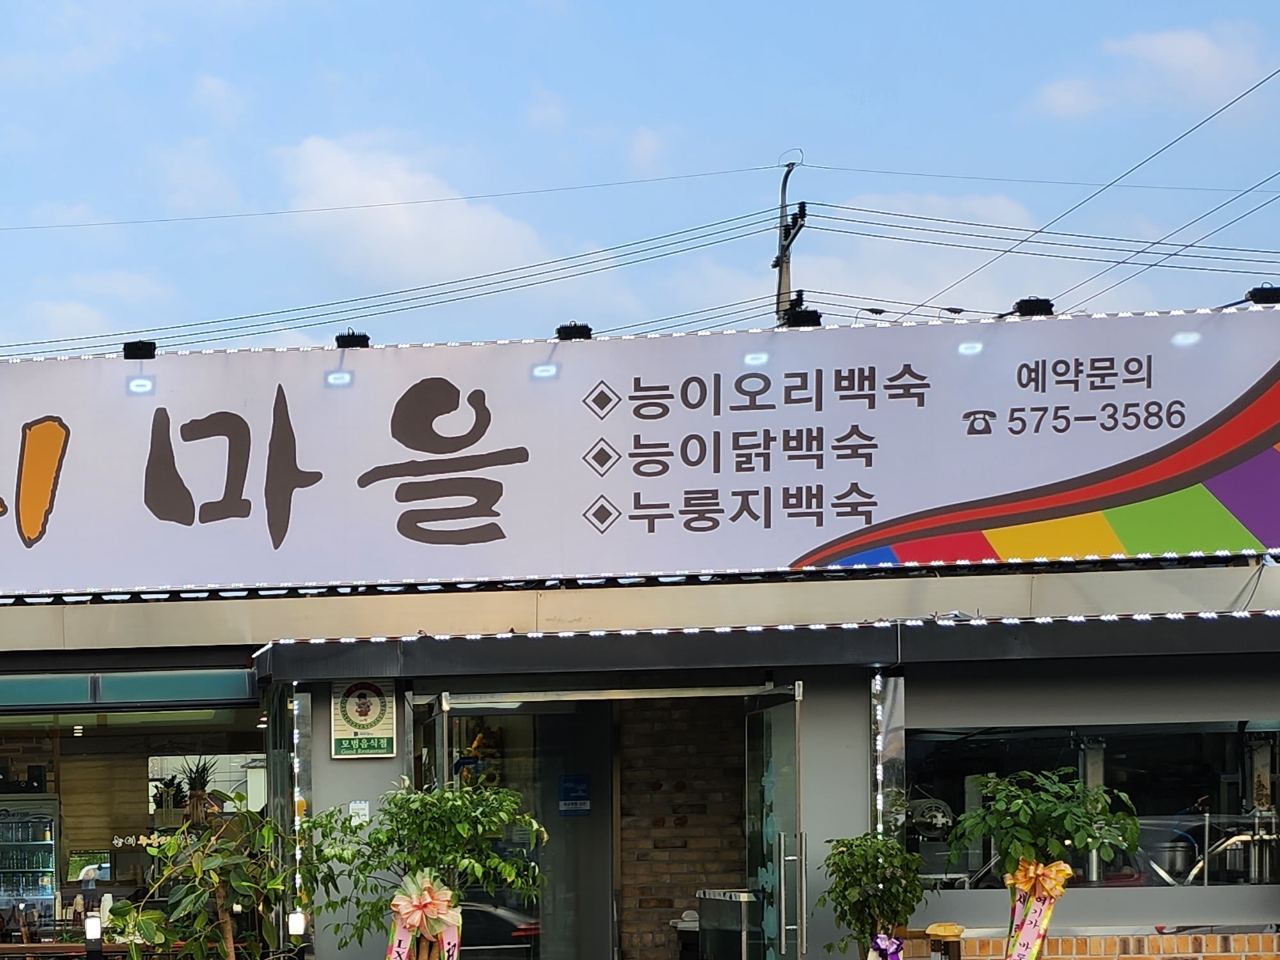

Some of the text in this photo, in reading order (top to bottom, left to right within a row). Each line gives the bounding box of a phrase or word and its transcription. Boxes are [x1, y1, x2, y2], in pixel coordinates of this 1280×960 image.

[627, 363, 932, 418] 능이오리백숙
[1016, 355, 1154, 393] 예약문의
[1006, 399, 1186, 436] 575-3586
[144, 376, 530, 550] 마을
[627, 424, 878, 478] 능이닭백숙
[627, 482, 878, 534] 누룽지백숙
[340, 738, 388, 749] 모범음식점
